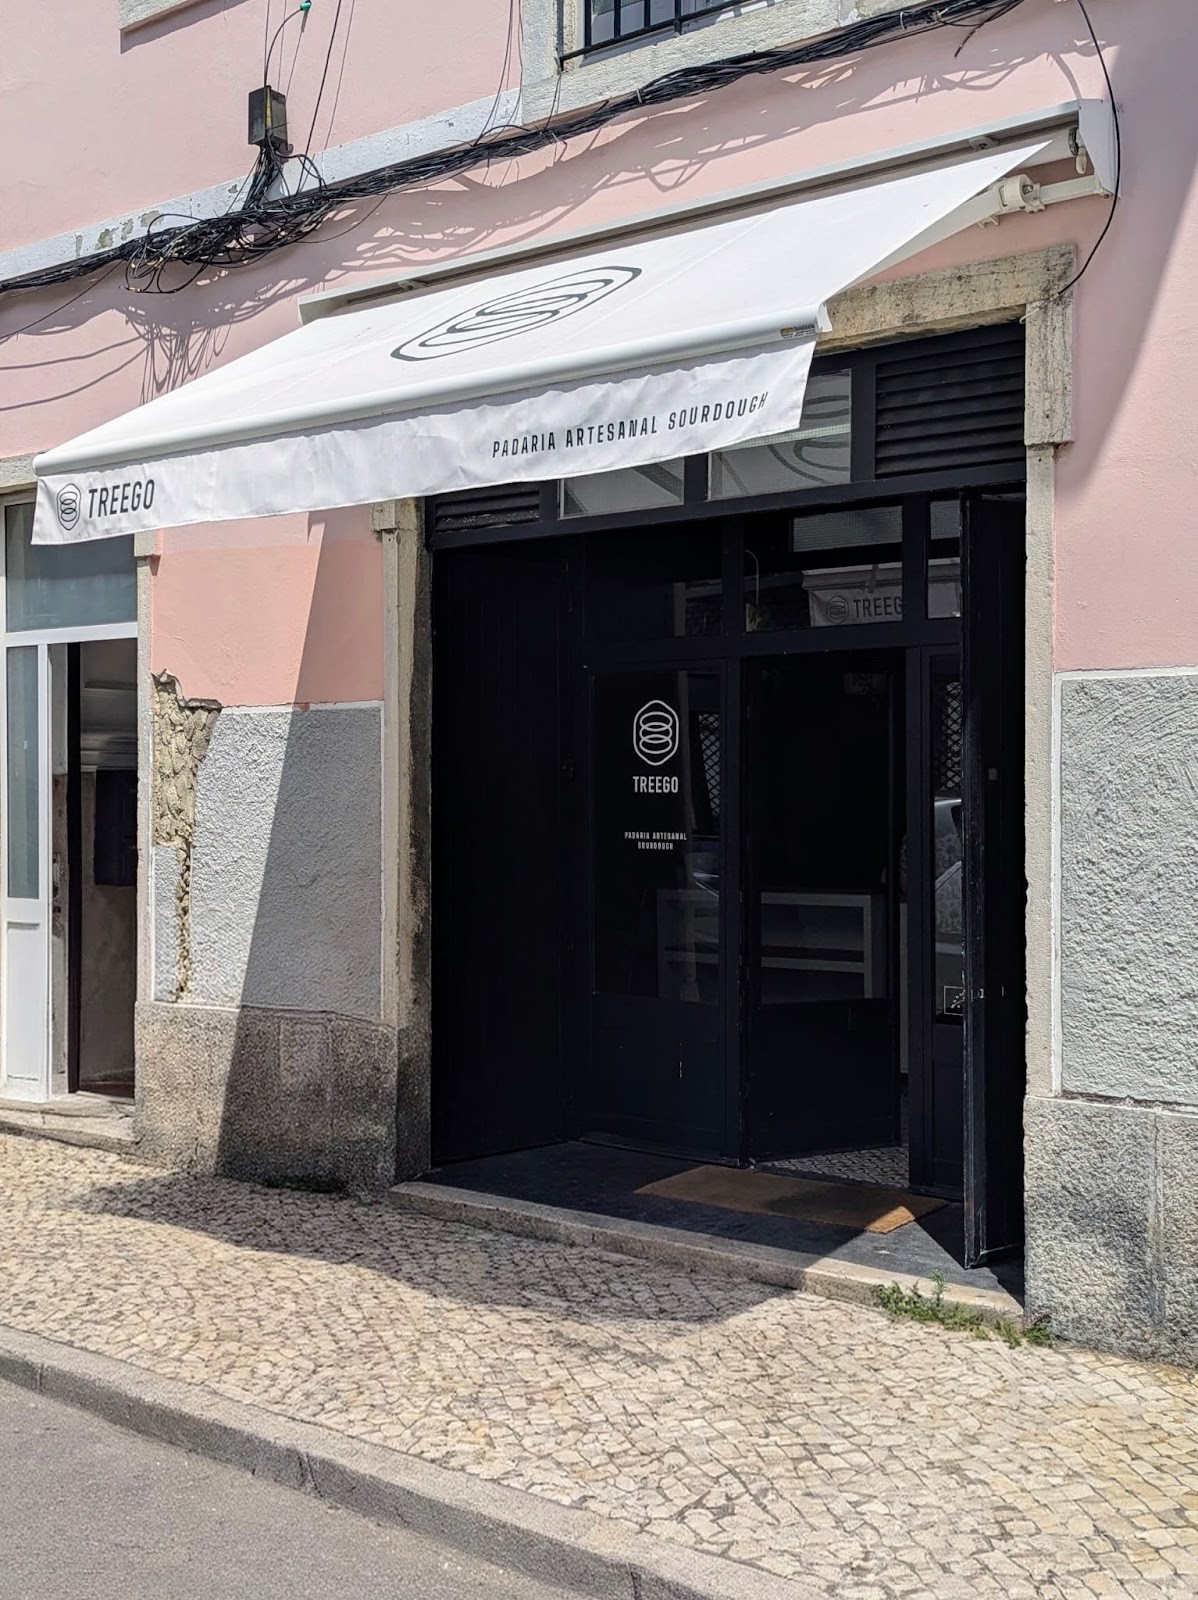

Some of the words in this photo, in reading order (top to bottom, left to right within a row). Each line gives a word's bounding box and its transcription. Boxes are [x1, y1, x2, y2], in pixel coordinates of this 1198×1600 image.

[492, 432, 556, 458] PADARIA
[565, 415, 657, 448] ARTESANAL
[668, 391, 769, 430] SOURDOUGH
[88, 479, 155, 518] TREEGO
[853, 596, 903, 618] TREEG
[632, 776, 679, 793] TREEGO
[624, 831, 650, 840] PADARIA
[652, 832, 687, 841] ARTESANAL
